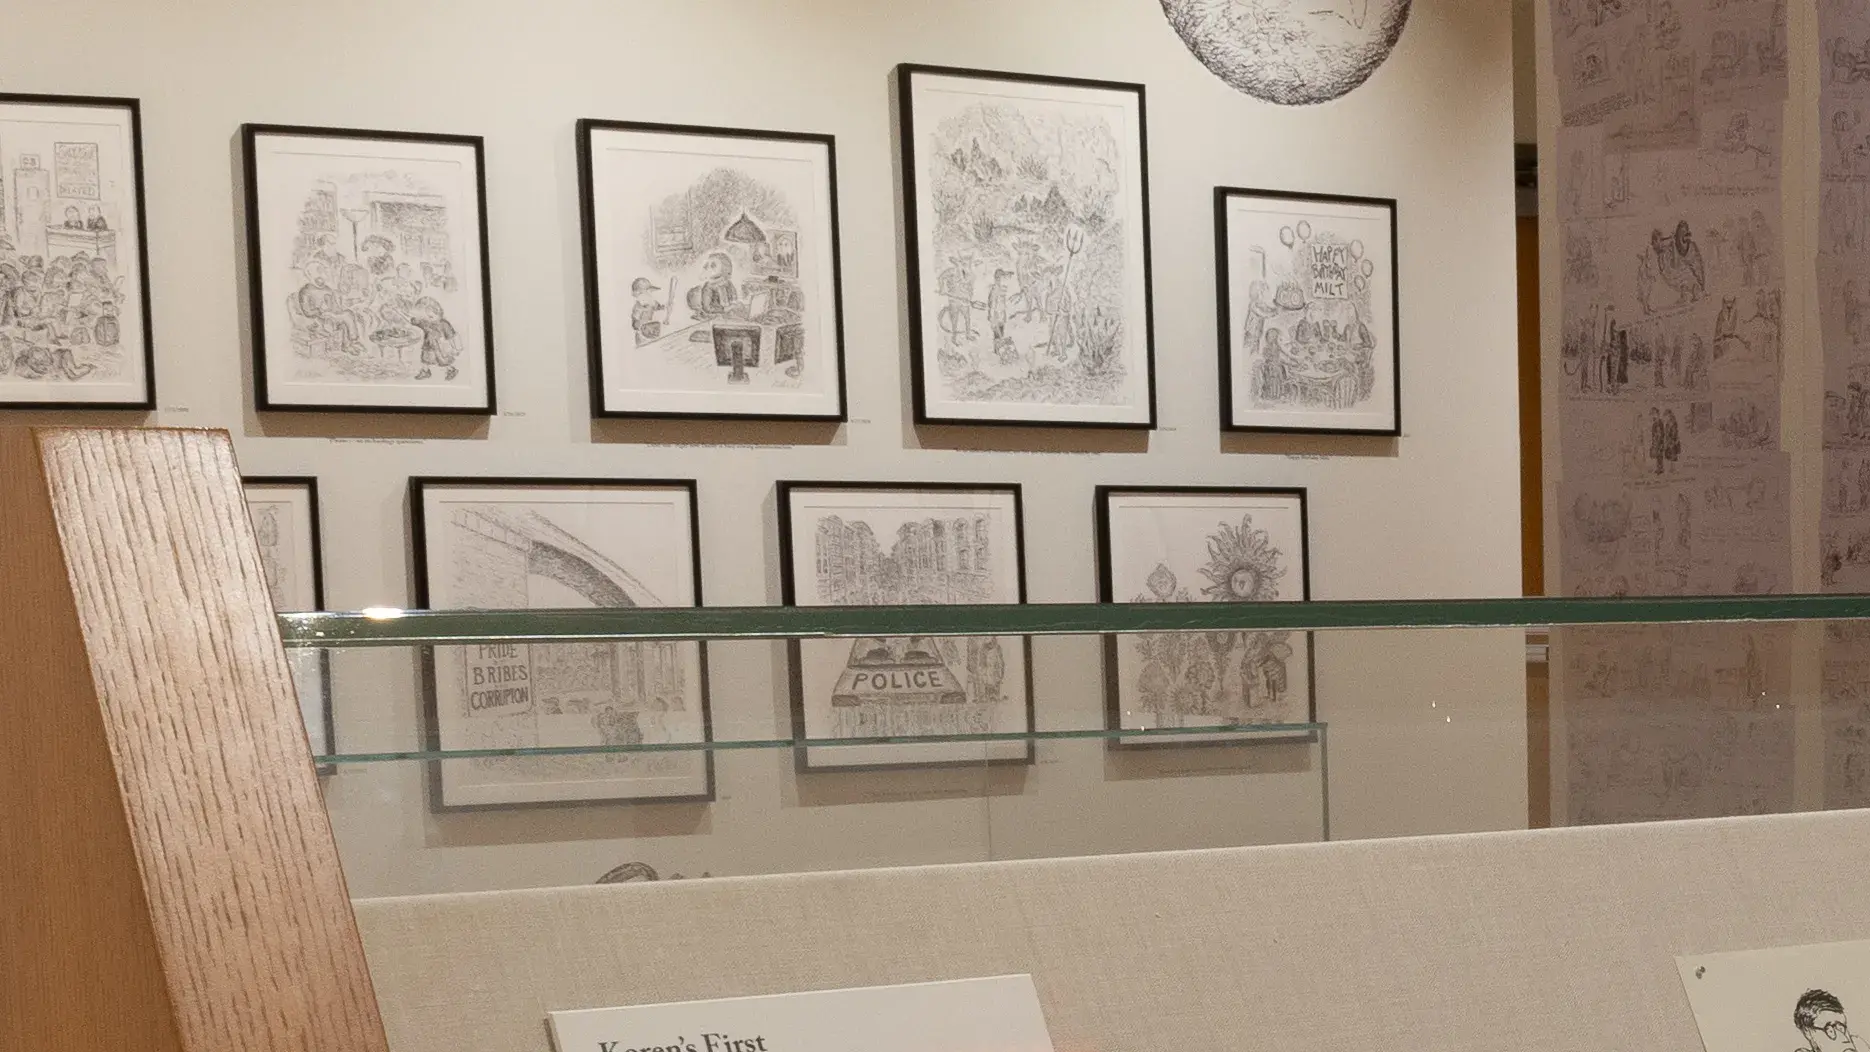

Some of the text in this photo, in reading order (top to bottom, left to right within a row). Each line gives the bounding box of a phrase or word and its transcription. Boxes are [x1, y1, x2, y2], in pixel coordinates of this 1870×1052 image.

[1314, 282, 1344, 296] MILT
[472, 664, 528, 685] BRIBES
[851, 670, 943, 690] POLICE
[470, 686, 529, 710] CORRUPTION
